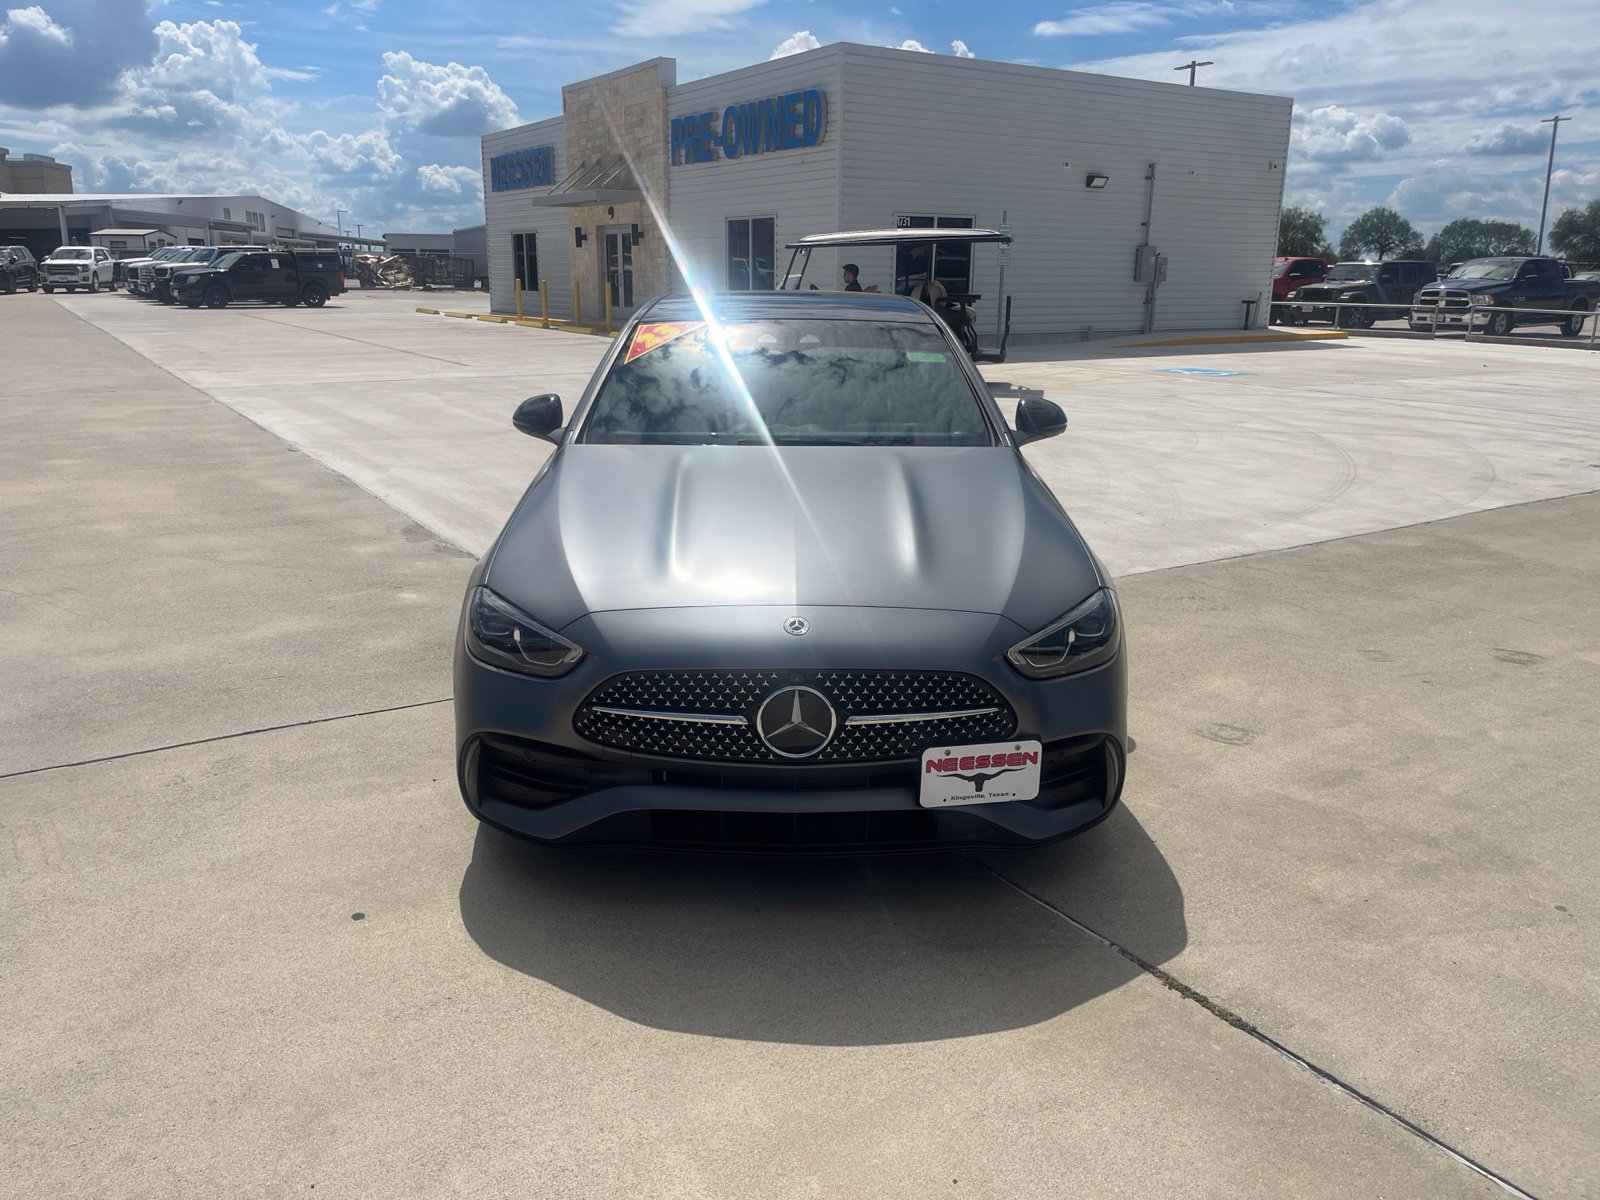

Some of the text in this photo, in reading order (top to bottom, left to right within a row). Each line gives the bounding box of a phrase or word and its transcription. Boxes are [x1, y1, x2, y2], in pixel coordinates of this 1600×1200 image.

[671, 89, 825, 166] PRE-OWNED
[491, 146, 553, 192] NEESSEN
[926, 751, 1038, 773] NEESSEN
